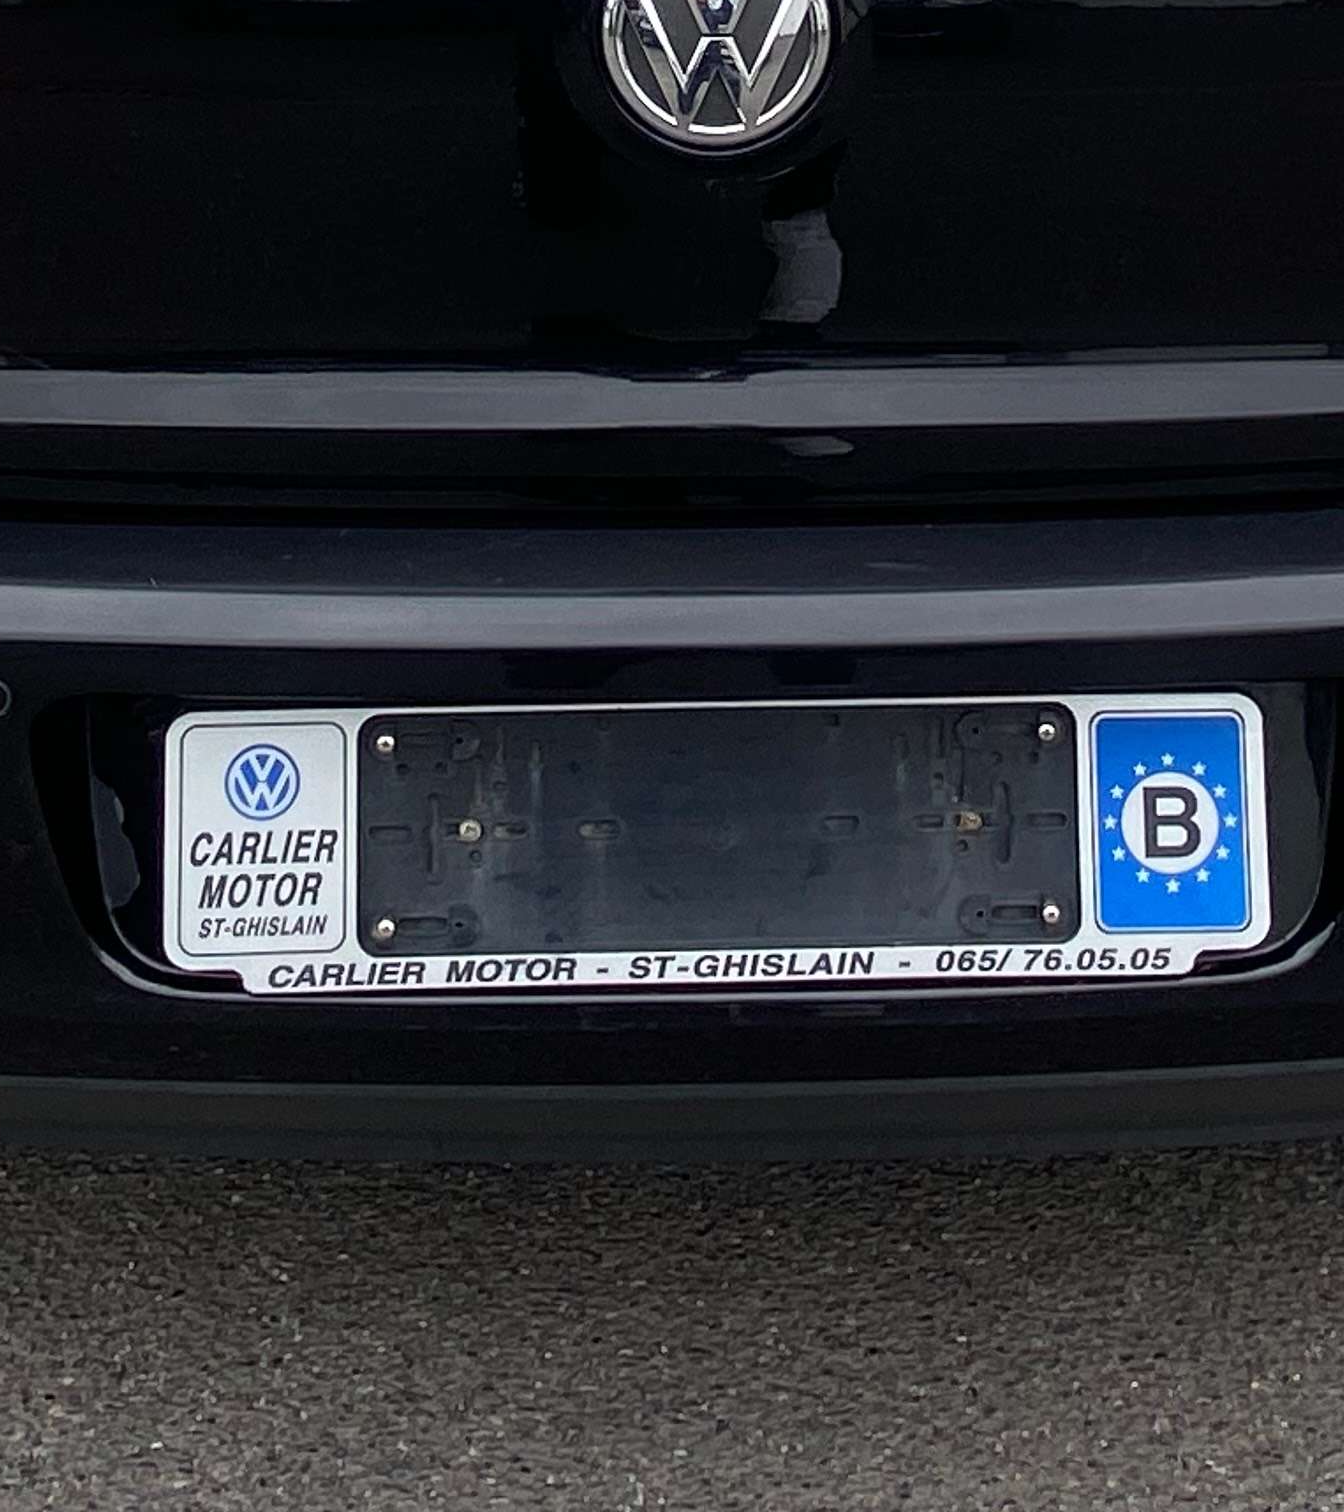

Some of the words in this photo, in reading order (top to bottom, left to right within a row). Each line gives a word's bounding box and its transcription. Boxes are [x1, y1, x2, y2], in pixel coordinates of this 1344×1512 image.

[1142, 786, 1202, 859] B
[189, 829, 338, 867] CARLIER
[197, 872, 323, 909] MOTOR
[198, 914, 328, 939] ST-GHISLAIN
[268, 961, 426, 988] CARLIER
[445, 957, 577, 984] MOTOR
[628, 951, 875, 979] ST-GHISLAIN
[935, 947, 1016, 973] 065/
[1022, 947, 1172, 972] 76.05.05
